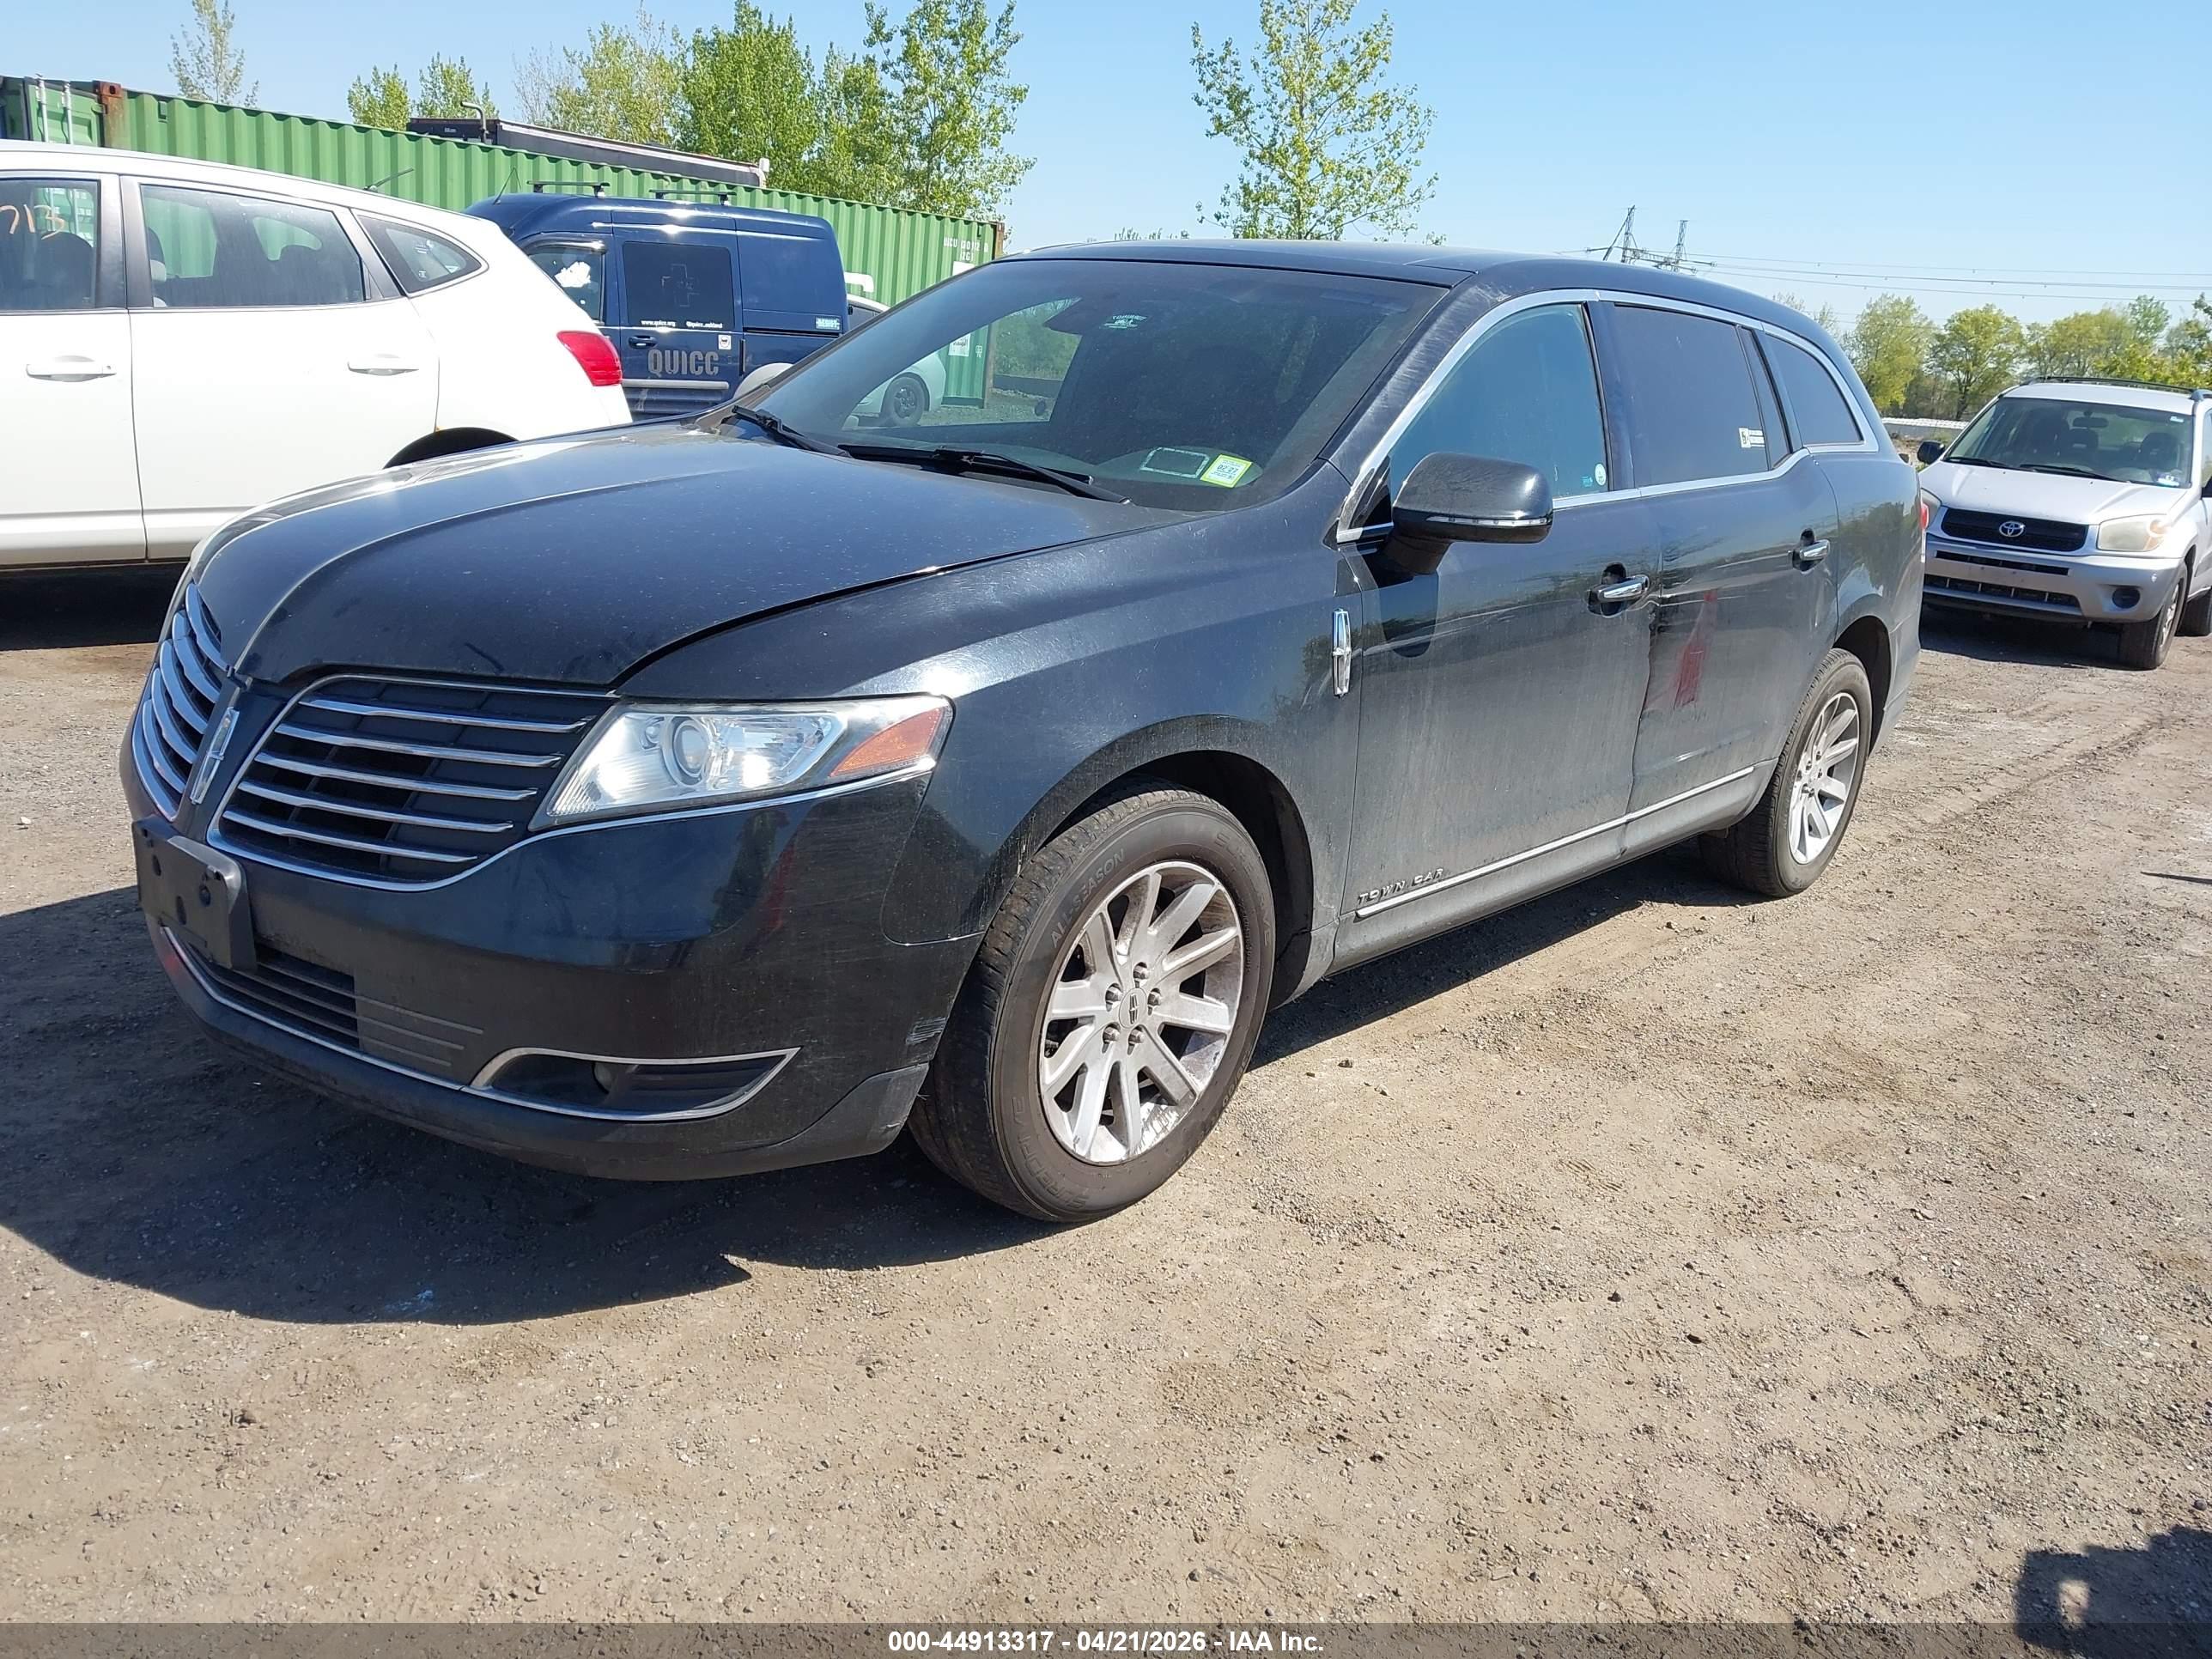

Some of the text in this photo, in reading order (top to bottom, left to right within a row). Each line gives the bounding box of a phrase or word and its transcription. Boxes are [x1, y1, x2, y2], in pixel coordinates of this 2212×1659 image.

[647, 349, 719, 376] QUICC
[1358, 868, 1443, 904] TOWN CAR
